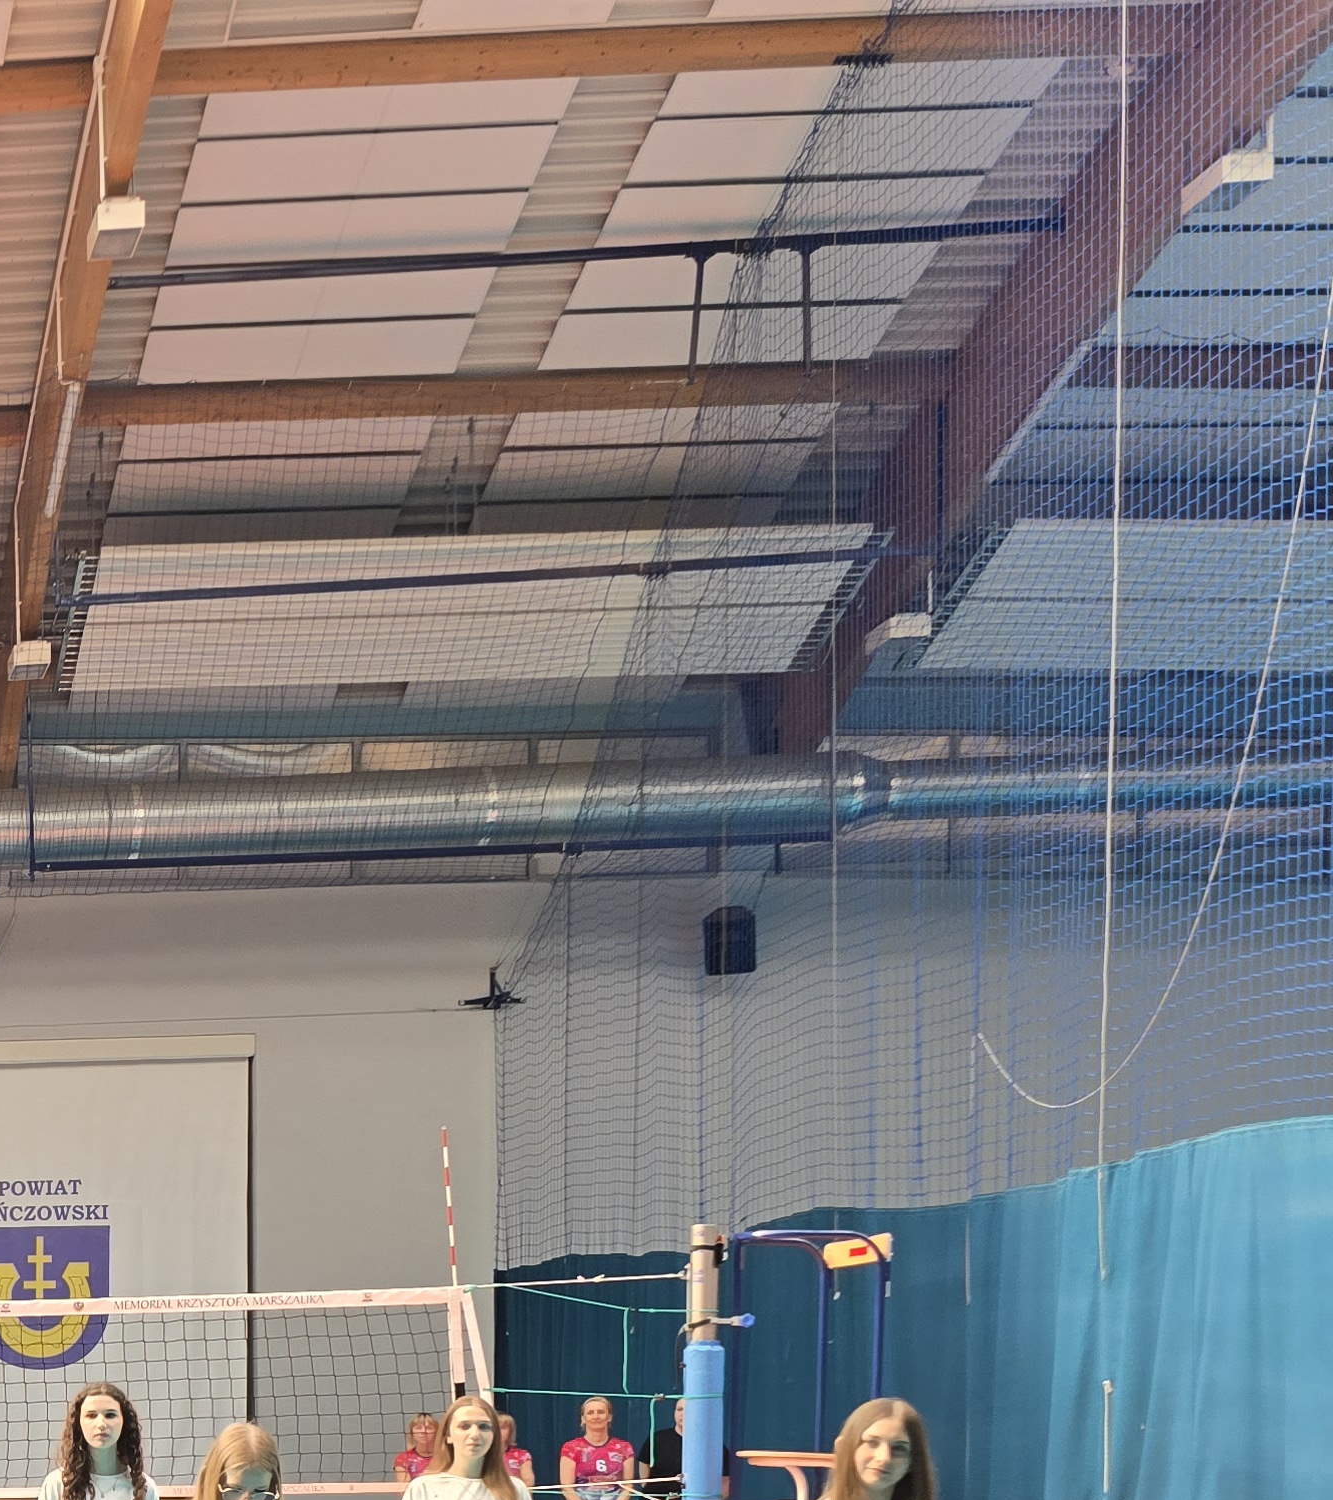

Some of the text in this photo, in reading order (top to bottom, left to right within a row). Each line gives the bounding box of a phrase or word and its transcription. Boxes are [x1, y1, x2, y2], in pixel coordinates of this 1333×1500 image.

[177, 1297, 250, 1308] KRZYSZTOFA
[252, 1295, 325, 1306] MARSZALIKA
[596, 1459, 608, 1472] 6
